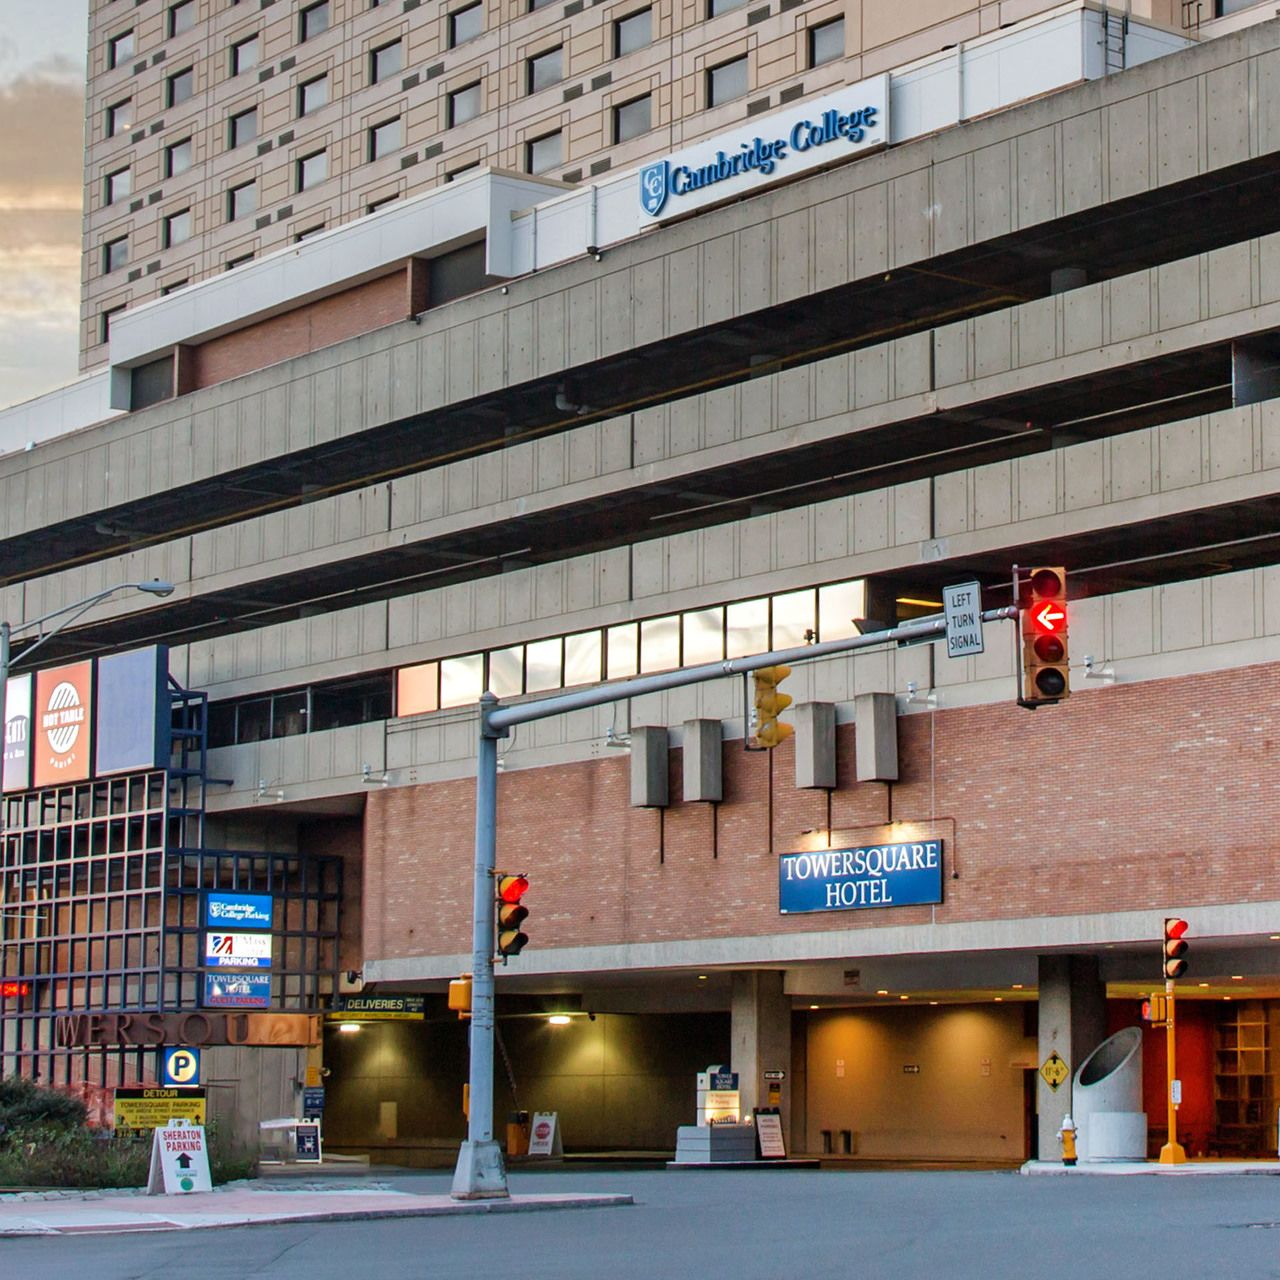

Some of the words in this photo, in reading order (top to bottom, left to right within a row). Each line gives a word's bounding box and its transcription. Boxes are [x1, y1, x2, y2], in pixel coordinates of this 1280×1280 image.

[669, 137, 787, 196] Cambridge
[789, 106, 878, 152] College
[951, 591, 972, 608] LEFT
[951, 612, 975, 629] TURN
[949, 633, 981, 650] SIGNAL
[783, 843, 938, 881] TOWERSQUARE
[825, 878, 893, 907] HOTEL
[218, 957, 259, 966] PARKING
[207, 974, 270, 984] TOWERSQUARE
[347, 999, 404, 1009] DELIVERIES
[174, 1056, 190, 1077] P
[143, 1089, 178, 1098] DETOUR
[162, 1130, 202, 1141] SHERATON
[165, 1140, 202, 1152] PARKING
